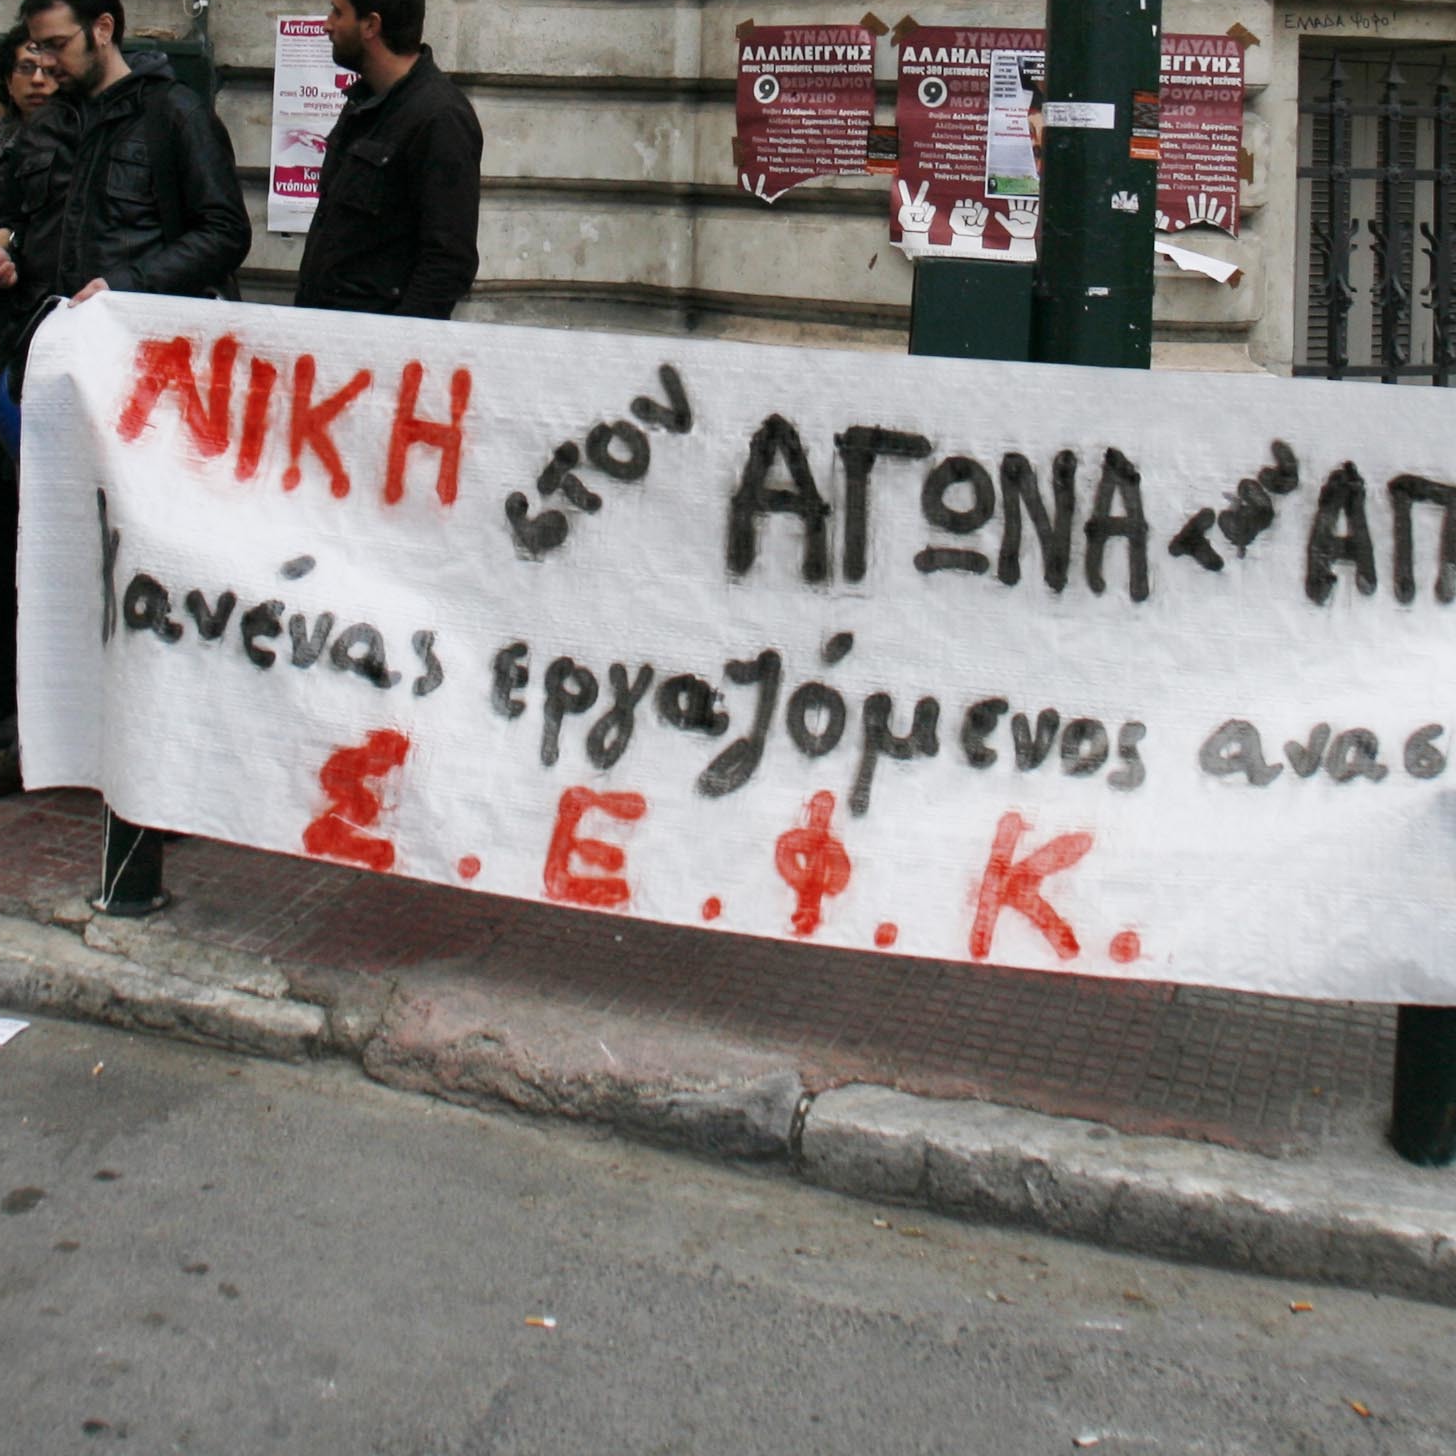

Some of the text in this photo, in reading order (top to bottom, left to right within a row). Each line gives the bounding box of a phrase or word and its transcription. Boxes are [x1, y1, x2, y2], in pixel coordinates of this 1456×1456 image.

[783, 29, 871, 45] ΣΥΝΑΥΛΙΑ
[954, 31, 1046, 48] ΣΥΝΑΥΛΙ
[742, 45, 872, 61] ΑΛΛΗΛΕΓΓΥΗΣ
[902, 46, 992, 63] ΑΛΛΗΛΕ
[1161, 38, 1239, 56] ΝΑΥΛΙΑ
[926, 65, 943, 75] 300
[1160, 55, 1241, 73] ΕΓΓΥΗΣ
[299, 86, 319, 97] 300
[758, 78, 775, 100] 9
[923, 81, 943, 102] 9
[950, 80, 988, 92] ΦΕΒΡ
[1160, 87, 1241, 102] ΡΟΥΑΡΙΟΥ
[1162, 104, 1197, 116] ΣΕΙΟ
[303, 167, 320, 181] Κοι
[117, 332, 473, 509] ΝΙΚΗ
[725, 412, 1150, 604] ΑΓΩΝΑ
[490, 629, 1148, 817] εργαζόμενος
